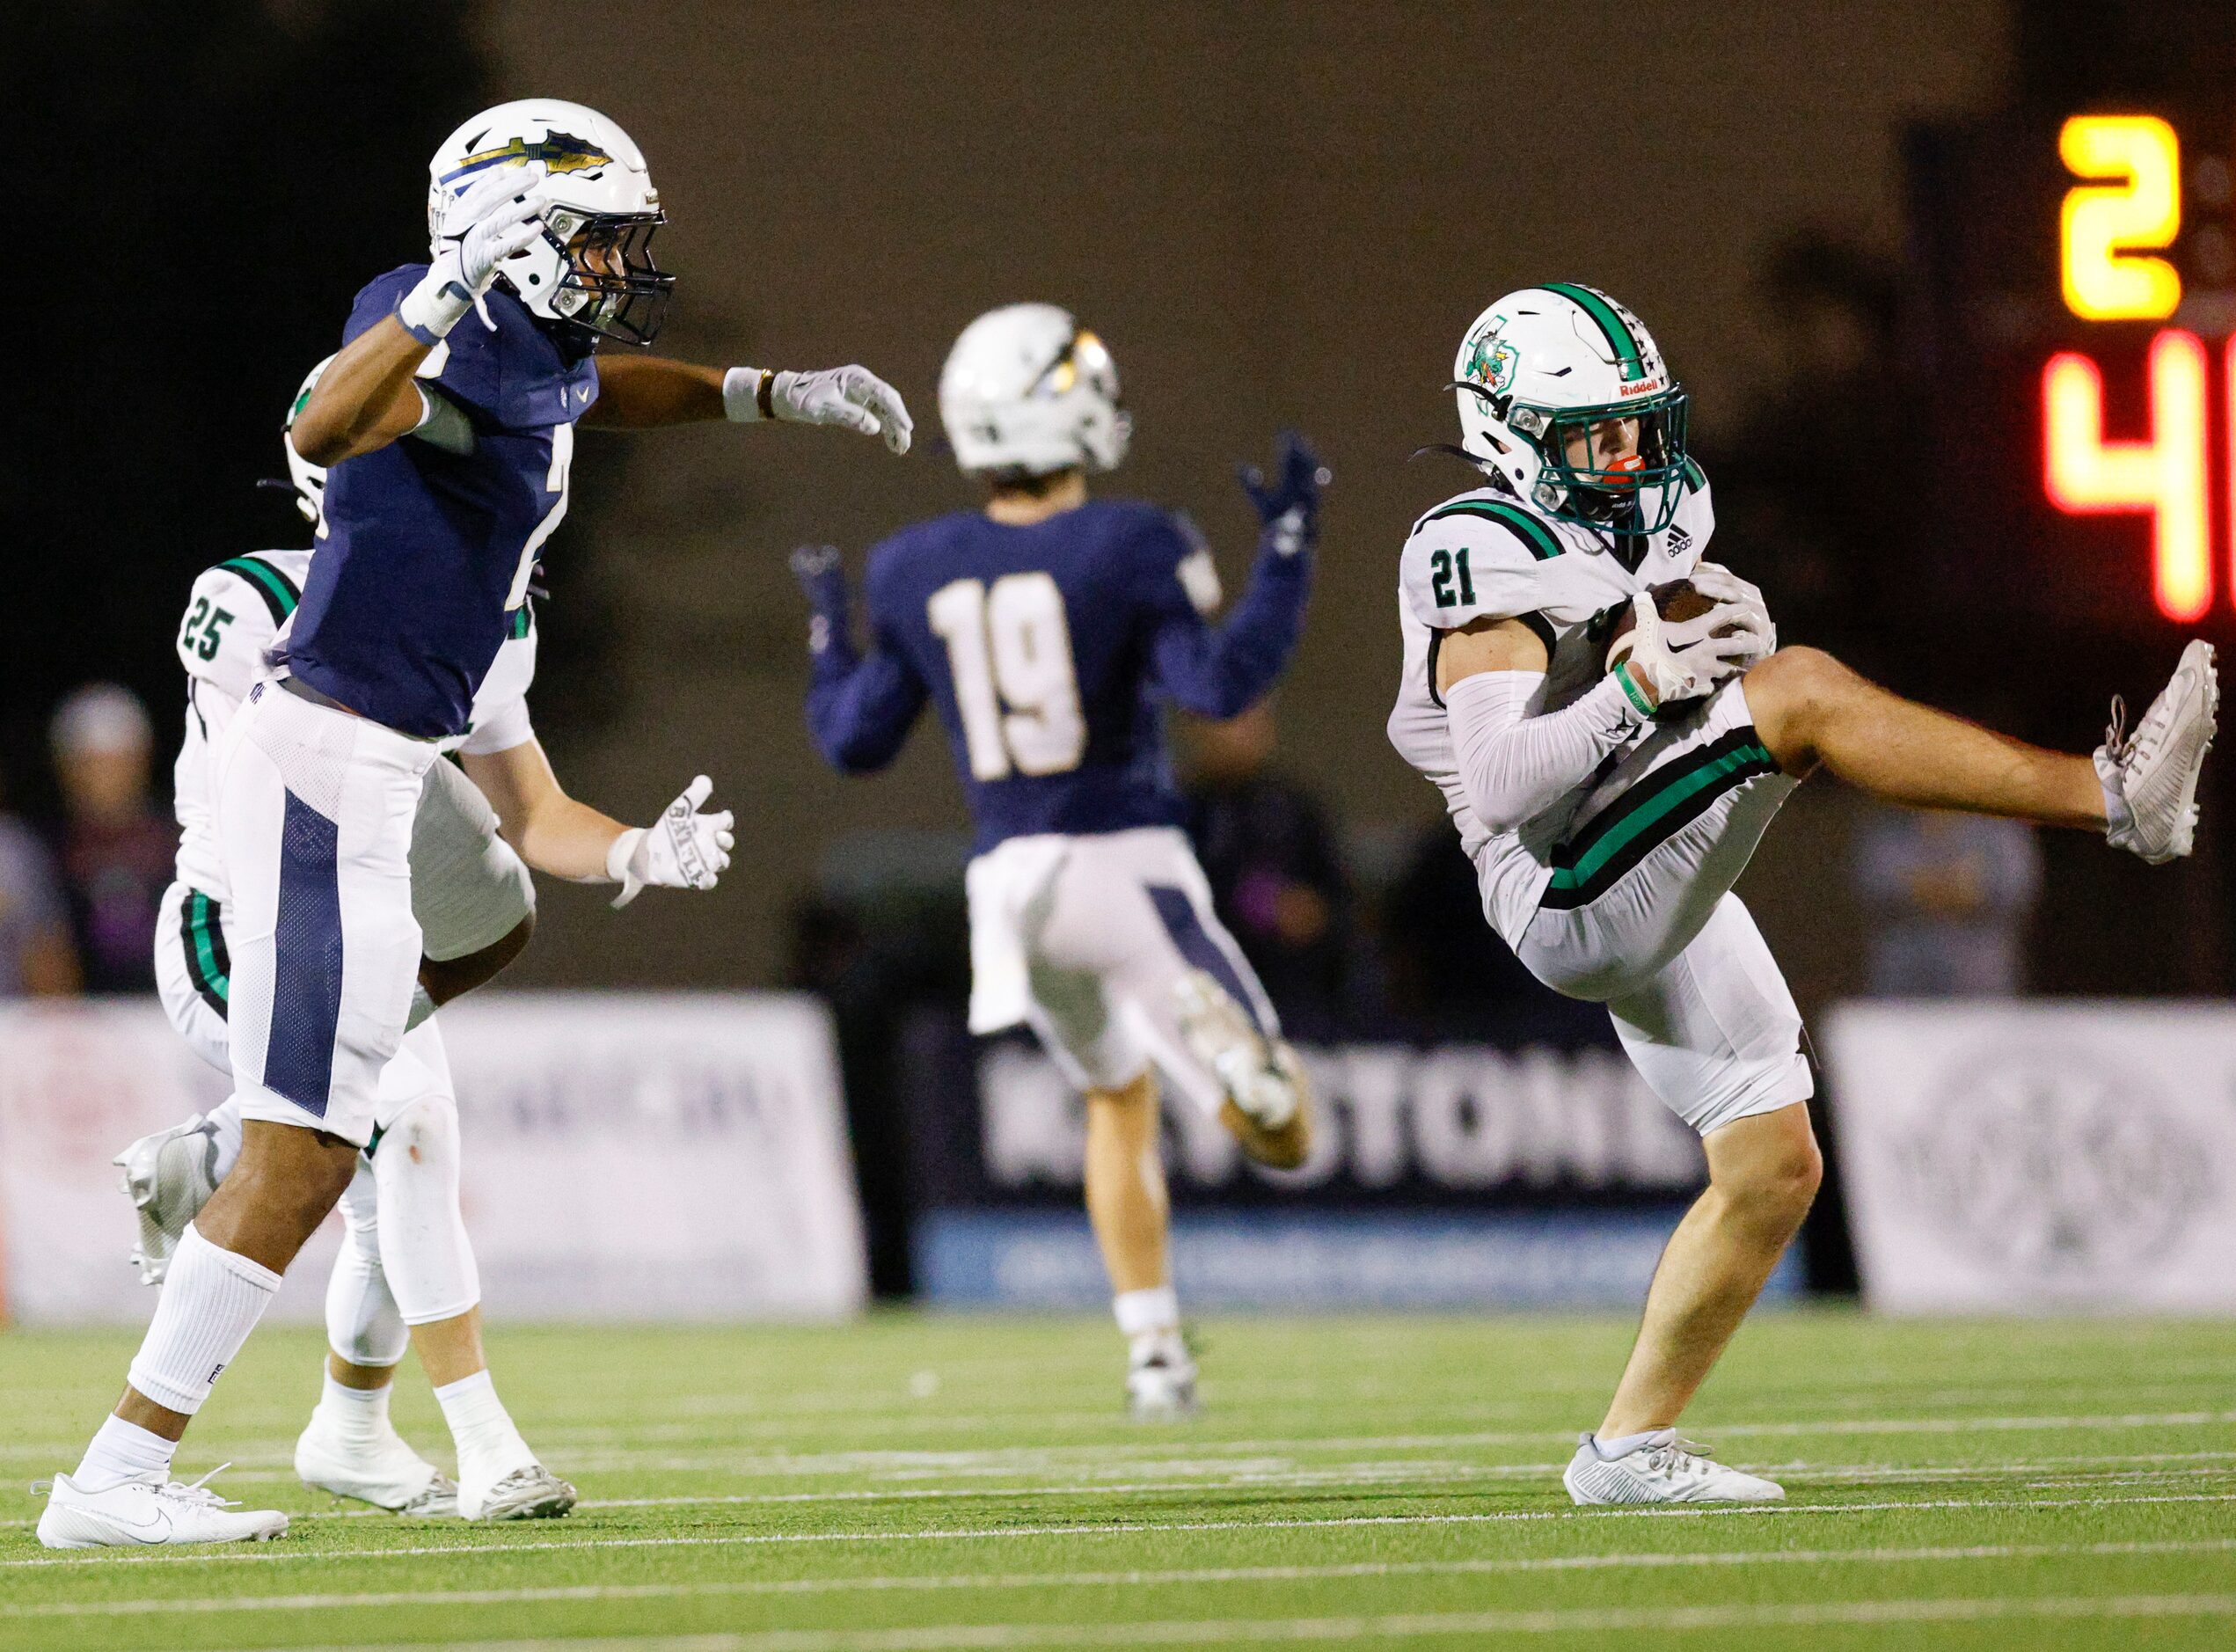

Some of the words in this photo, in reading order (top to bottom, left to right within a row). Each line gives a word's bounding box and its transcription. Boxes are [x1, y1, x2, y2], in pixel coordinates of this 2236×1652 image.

[2059, 114, 2181, 321] 2
[1619, 379, 1658, 396] Riddell
[2042, 328, 2236, 623] 4
[1430, 547, 1476, 608] 21
[1668, 537, 1692, 558] adida
[183, 596, 236, 662] 25
[926, 570, 1090, 782] 19
